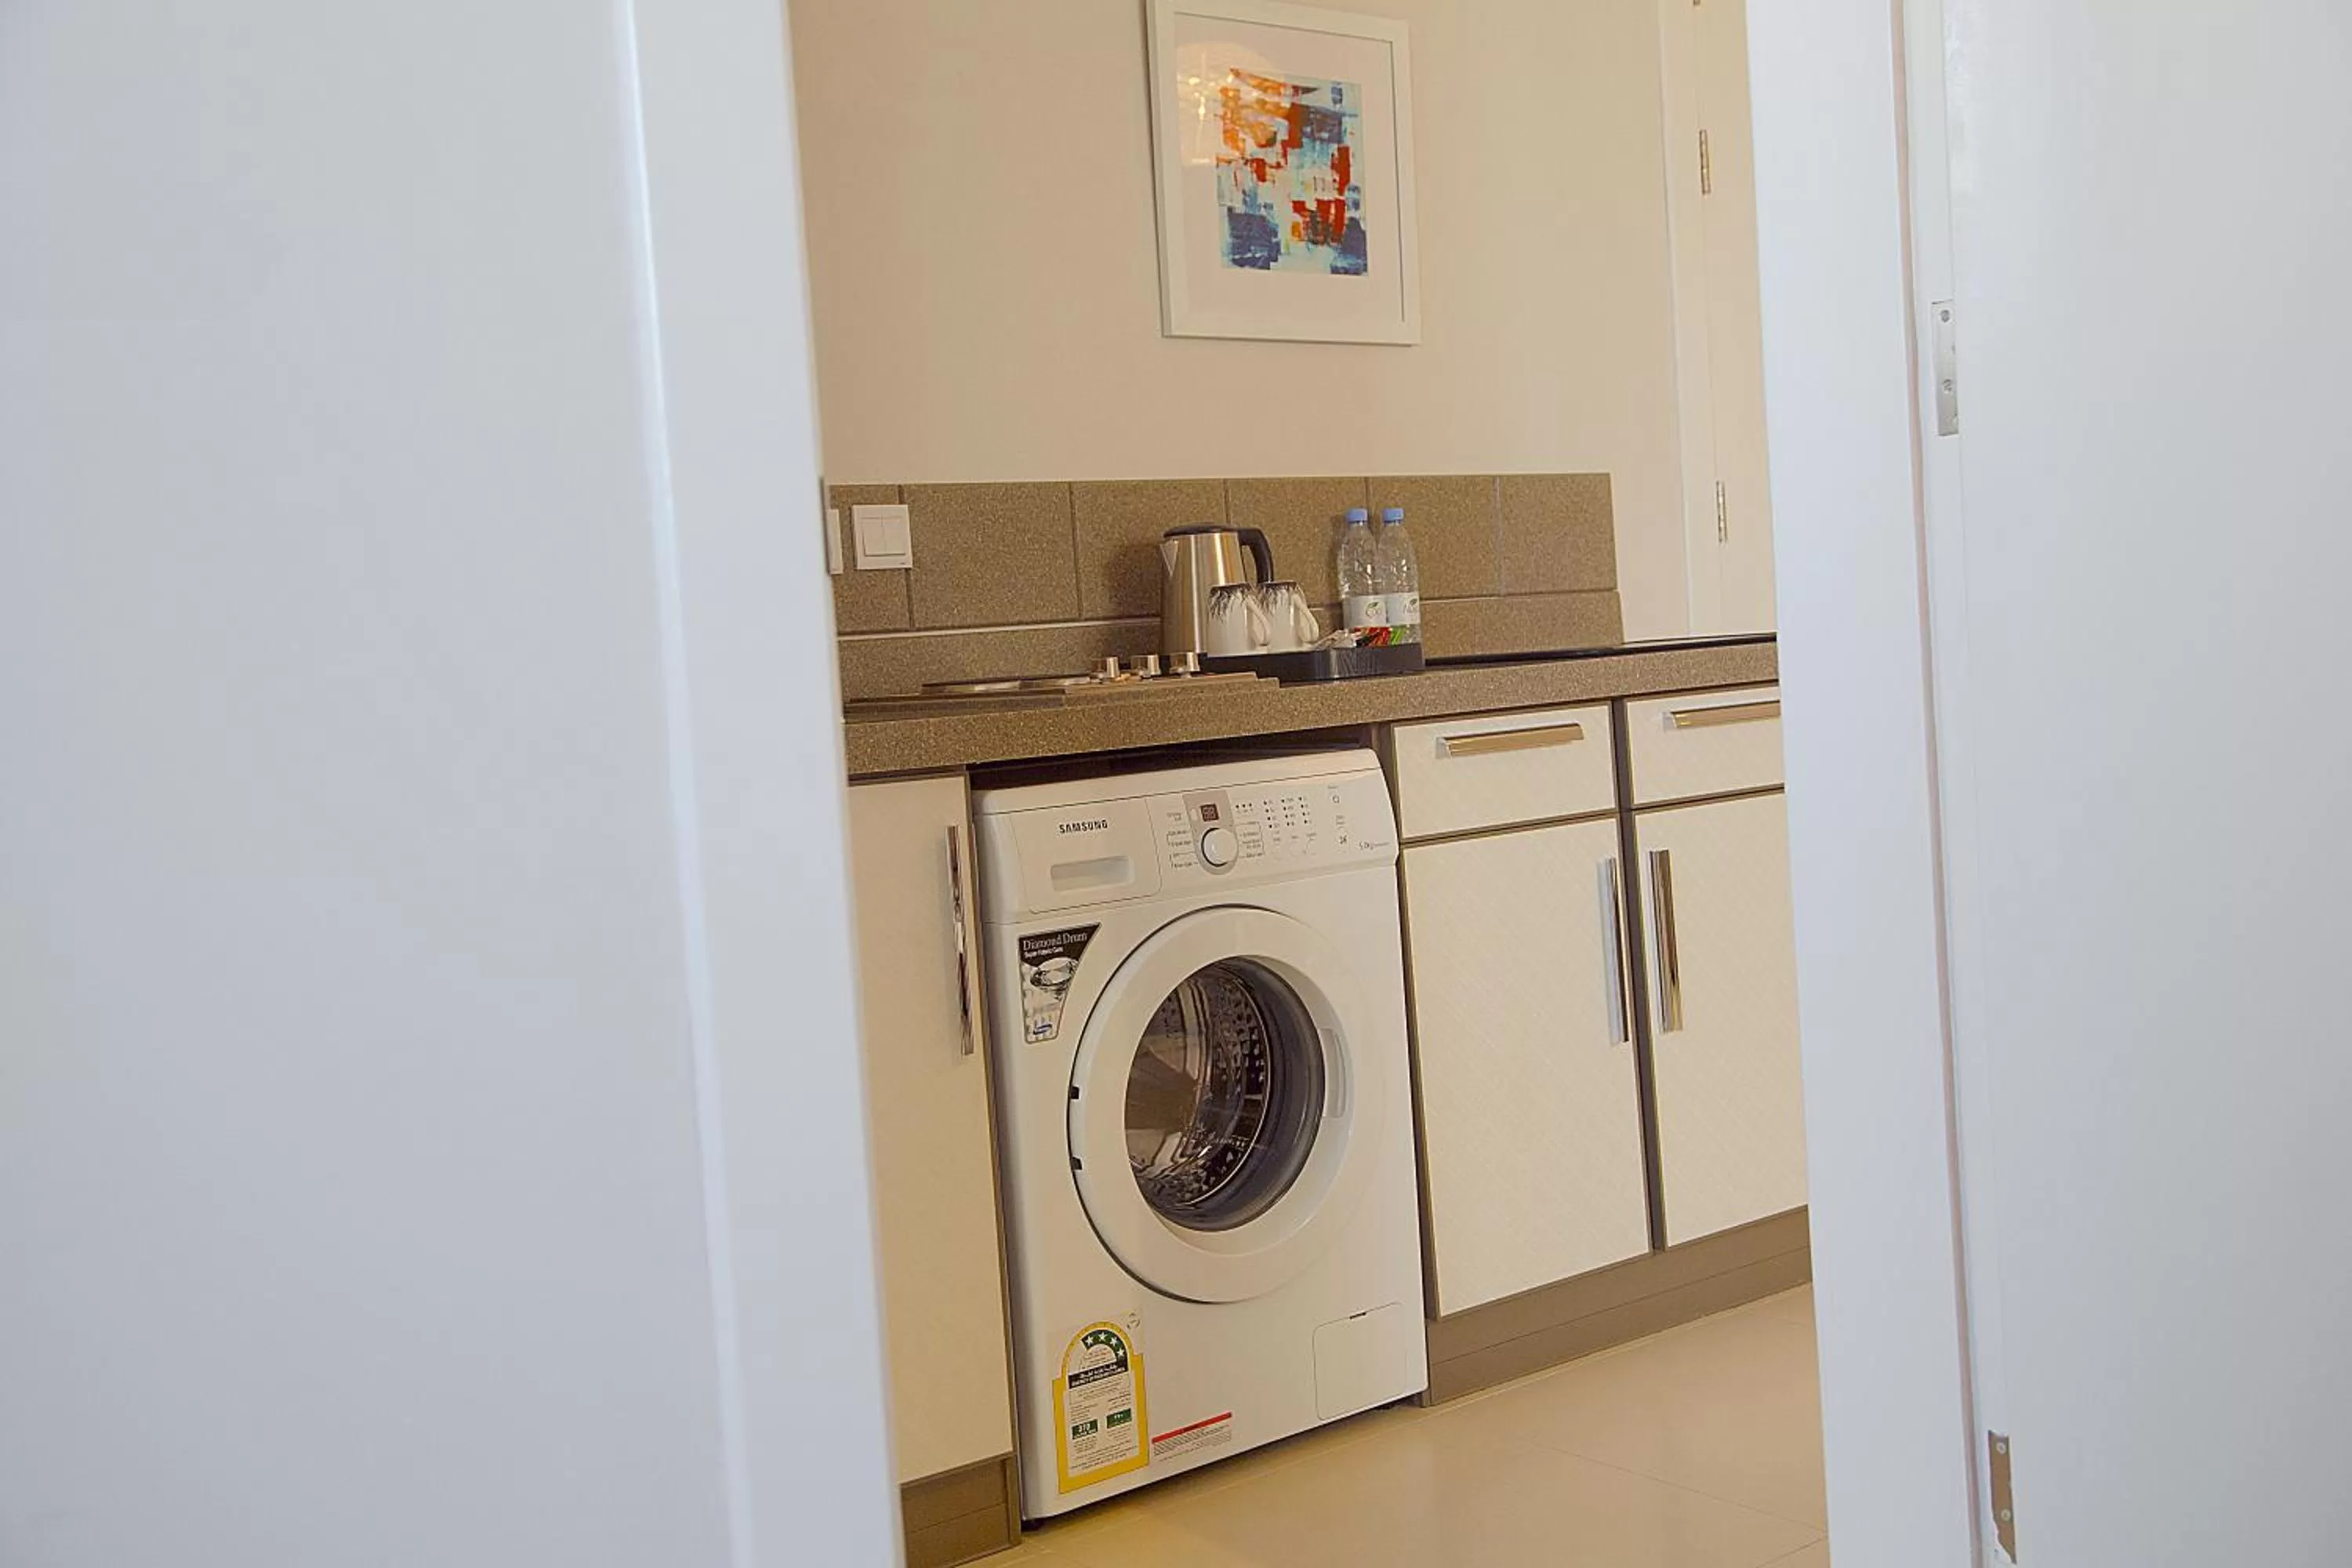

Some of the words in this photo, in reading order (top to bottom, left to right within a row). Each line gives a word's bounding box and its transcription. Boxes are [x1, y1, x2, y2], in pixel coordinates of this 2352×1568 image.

[1059, 819, 1108, 833] SAMSUNG
[1022, 934, 1062, 951] Diamond
[1062, 932, 1087, 945] Drum
